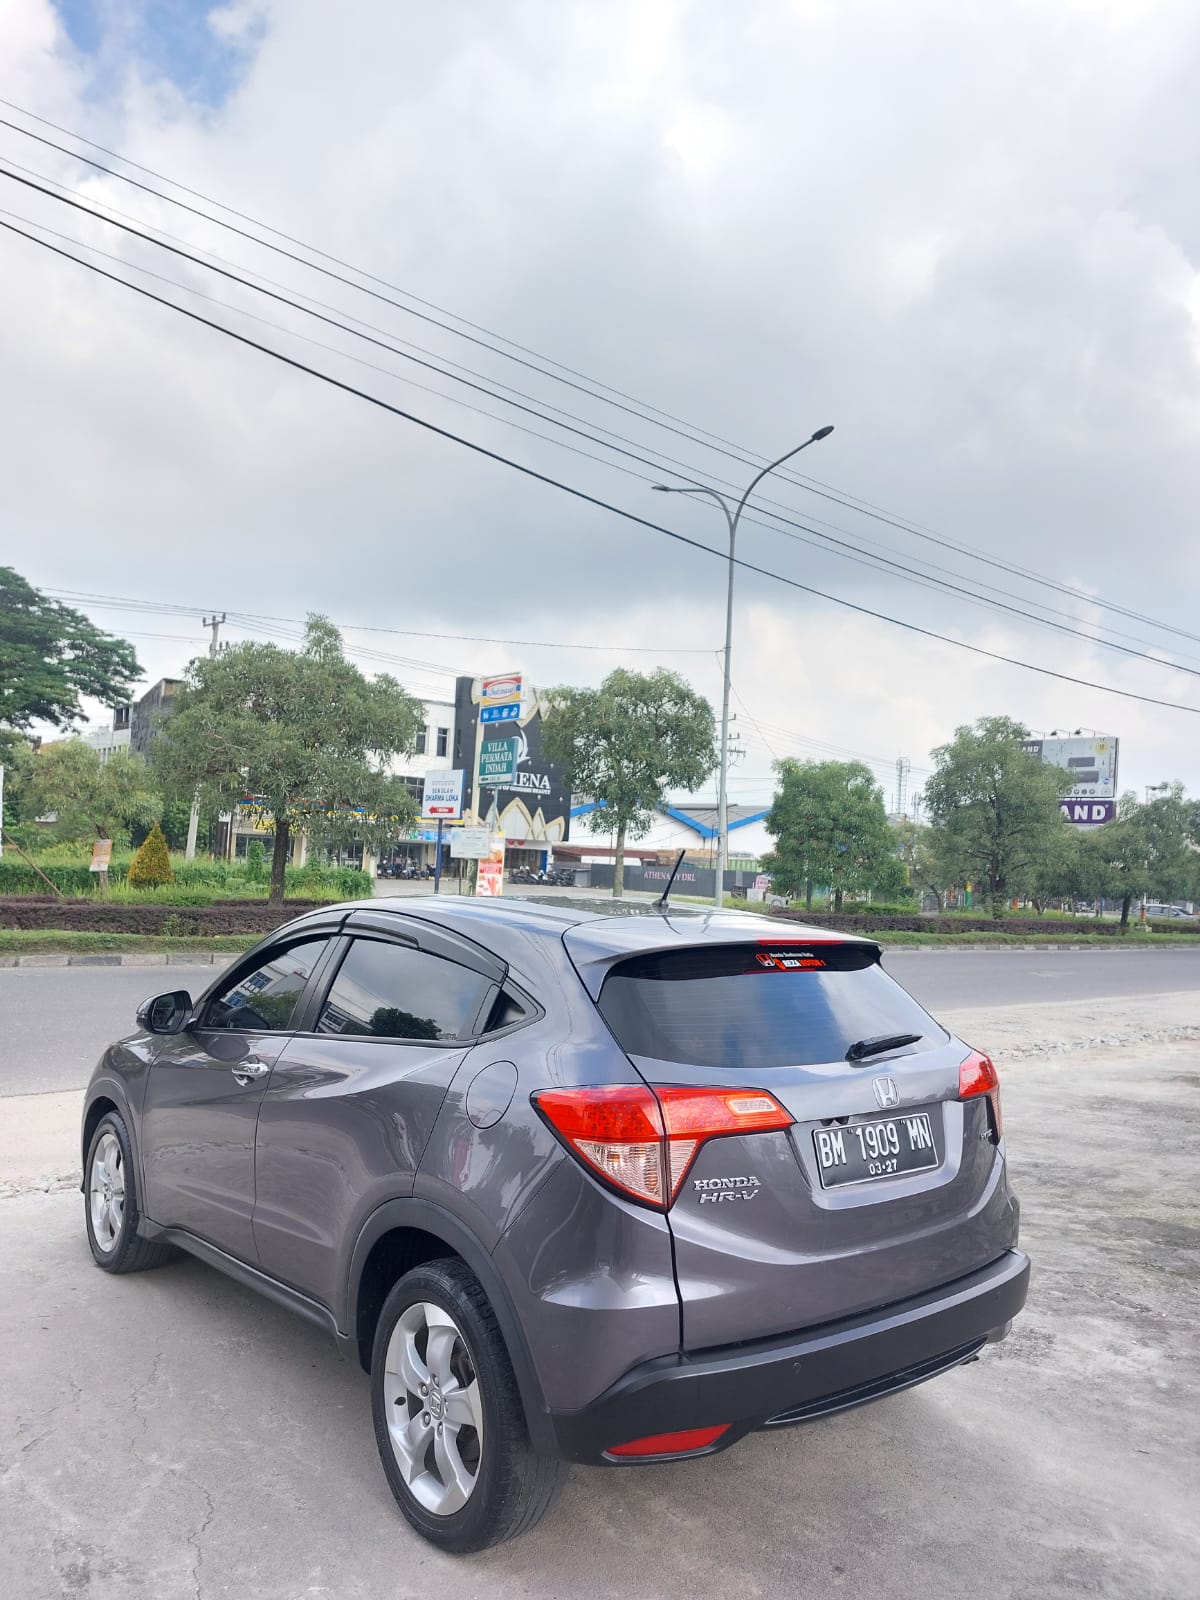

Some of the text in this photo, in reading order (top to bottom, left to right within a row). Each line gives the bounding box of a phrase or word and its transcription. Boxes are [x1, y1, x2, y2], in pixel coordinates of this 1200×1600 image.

[487, 741, 508, 752] VILLA
[481, 751, 513, 764] PERMATA
[485, 762, 507, 774] INDAH
[513, 771, 551, 789] ENA
[643, 871, 670, 880] ATHENA
[681, 873, 696, 881] DRL
[818, 1117, 931, 1168] BM 1909 MN
[693, 1176, 761, 1191] HONDA
[699, 1189, 759, 1204] HR-V
